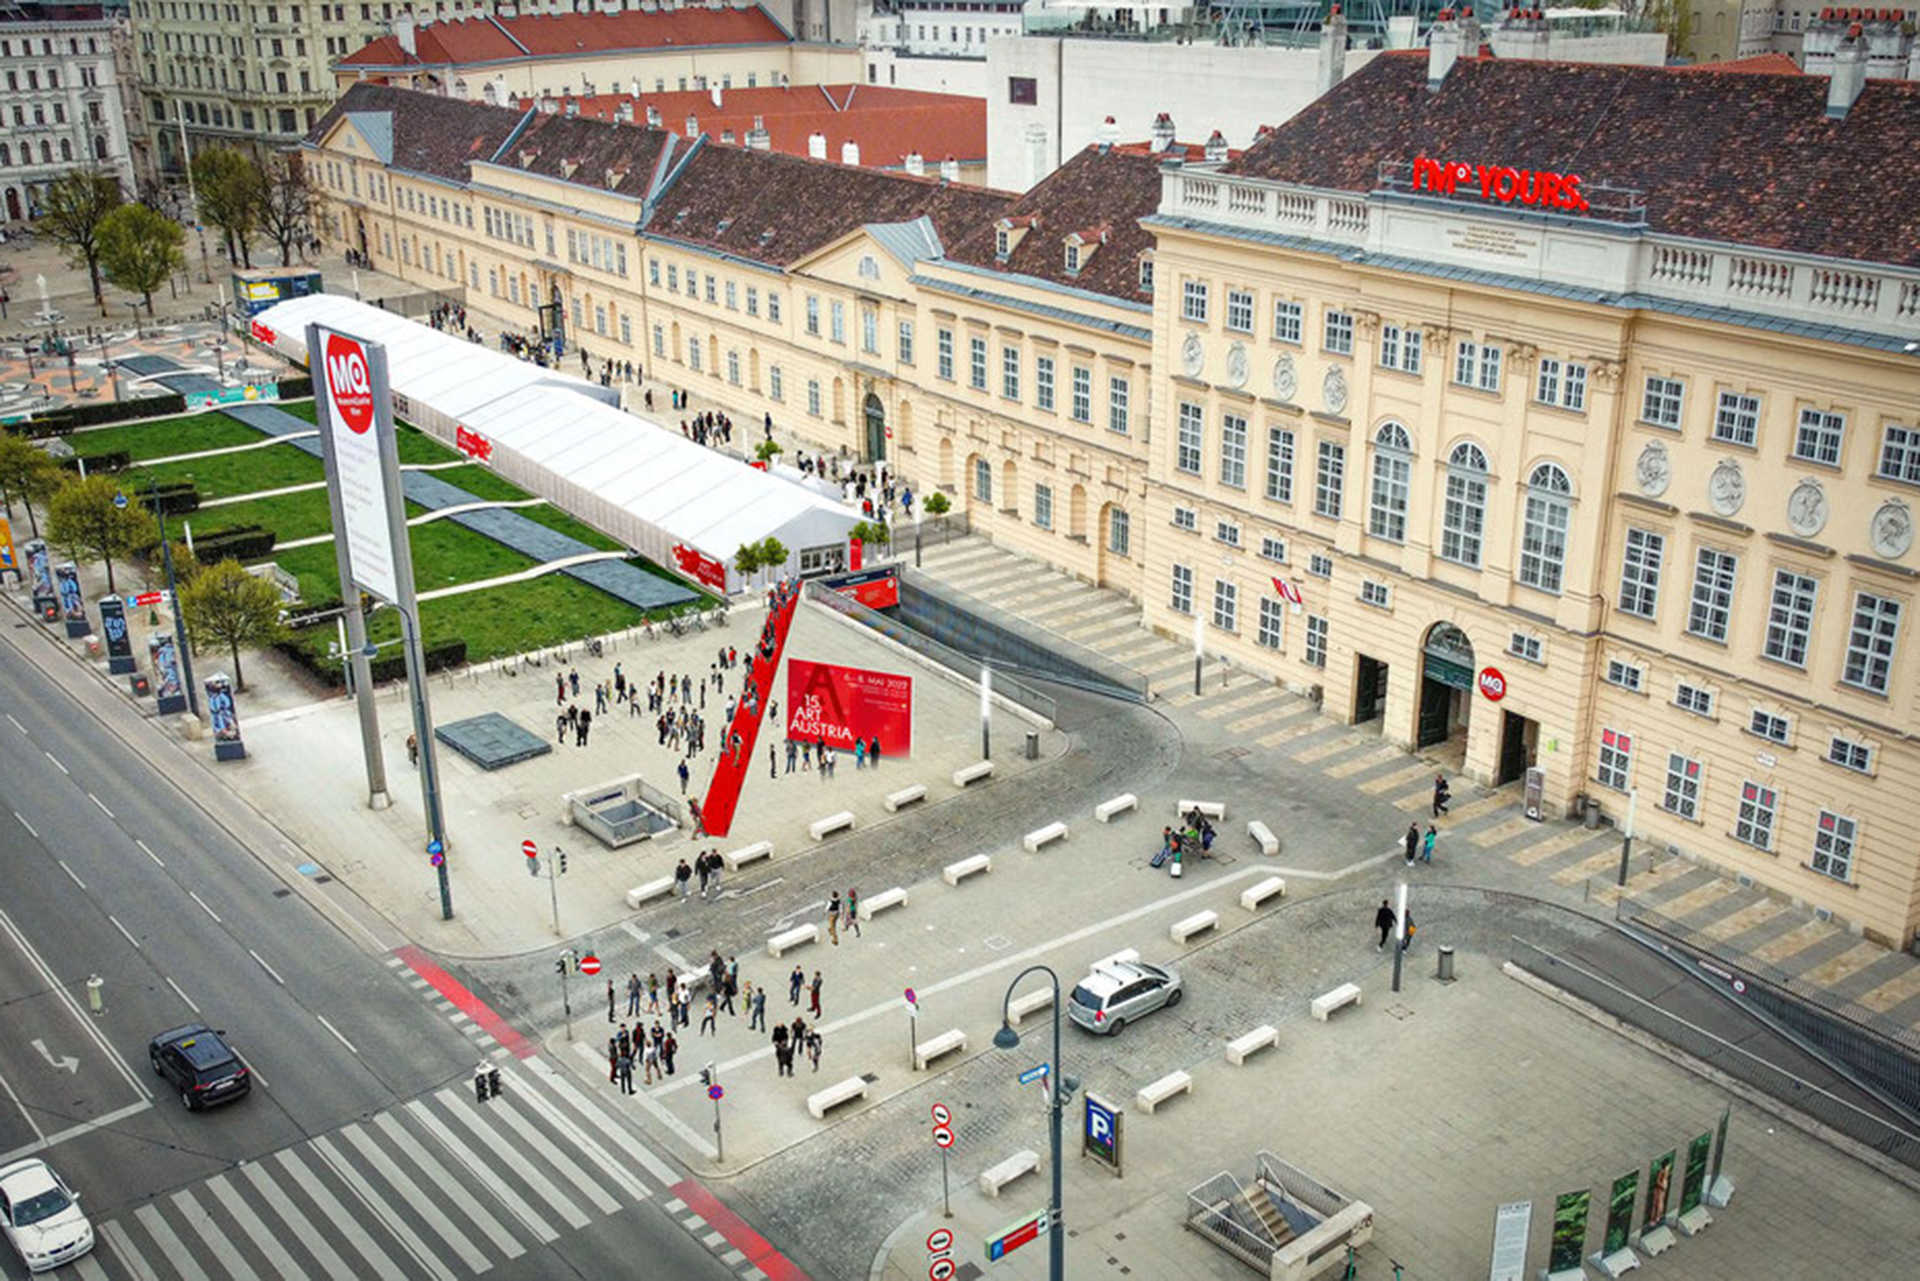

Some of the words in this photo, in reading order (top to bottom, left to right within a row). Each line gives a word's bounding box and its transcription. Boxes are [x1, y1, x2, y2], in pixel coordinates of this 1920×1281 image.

[1476, 165, 1590, 211] YOURS.
[329, 352, 371, 395] MQ
[1481, 673, 1503, 693] MQ
[794, 705, 822, 723] ART
[789, 718, 854, 741] AUSTRIA
[1092, 1112, 1109, 1138] P
